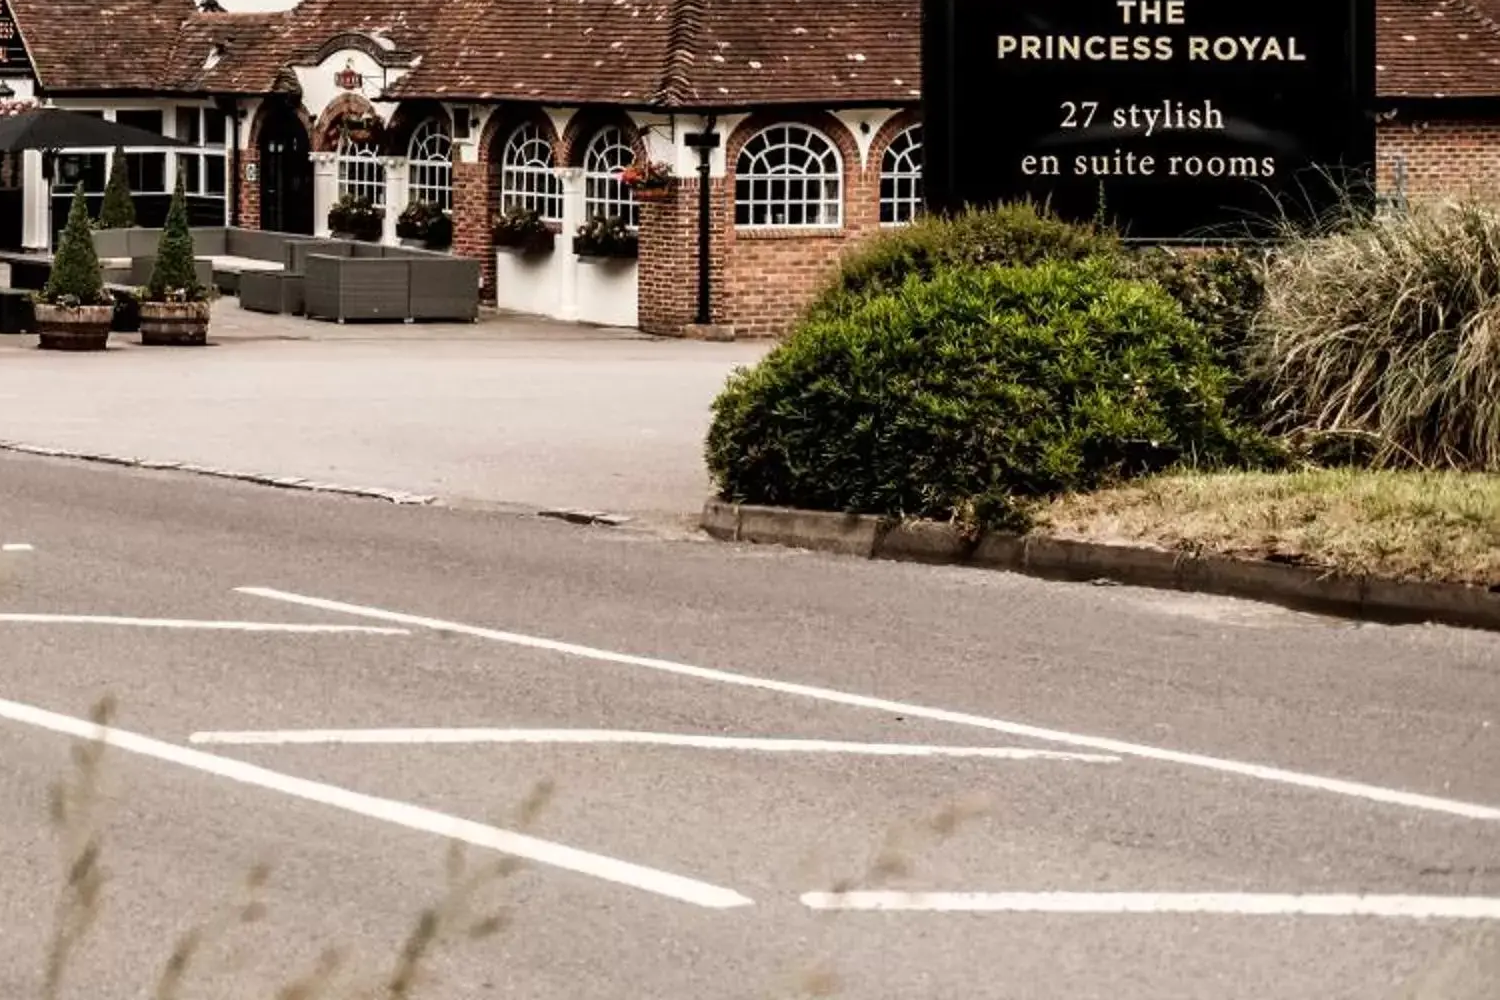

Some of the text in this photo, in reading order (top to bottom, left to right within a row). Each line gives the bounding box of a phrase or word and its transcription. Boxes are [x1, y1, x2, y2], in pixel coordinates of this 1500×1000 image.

[1116, 0, 1185, 25] THE
[997, 35, 1306, 61] PRINCESS ROYAL
[1060, 99, 1225, 137] 27 stylish
[1021, 148, 1276, 177] en suite rooms
